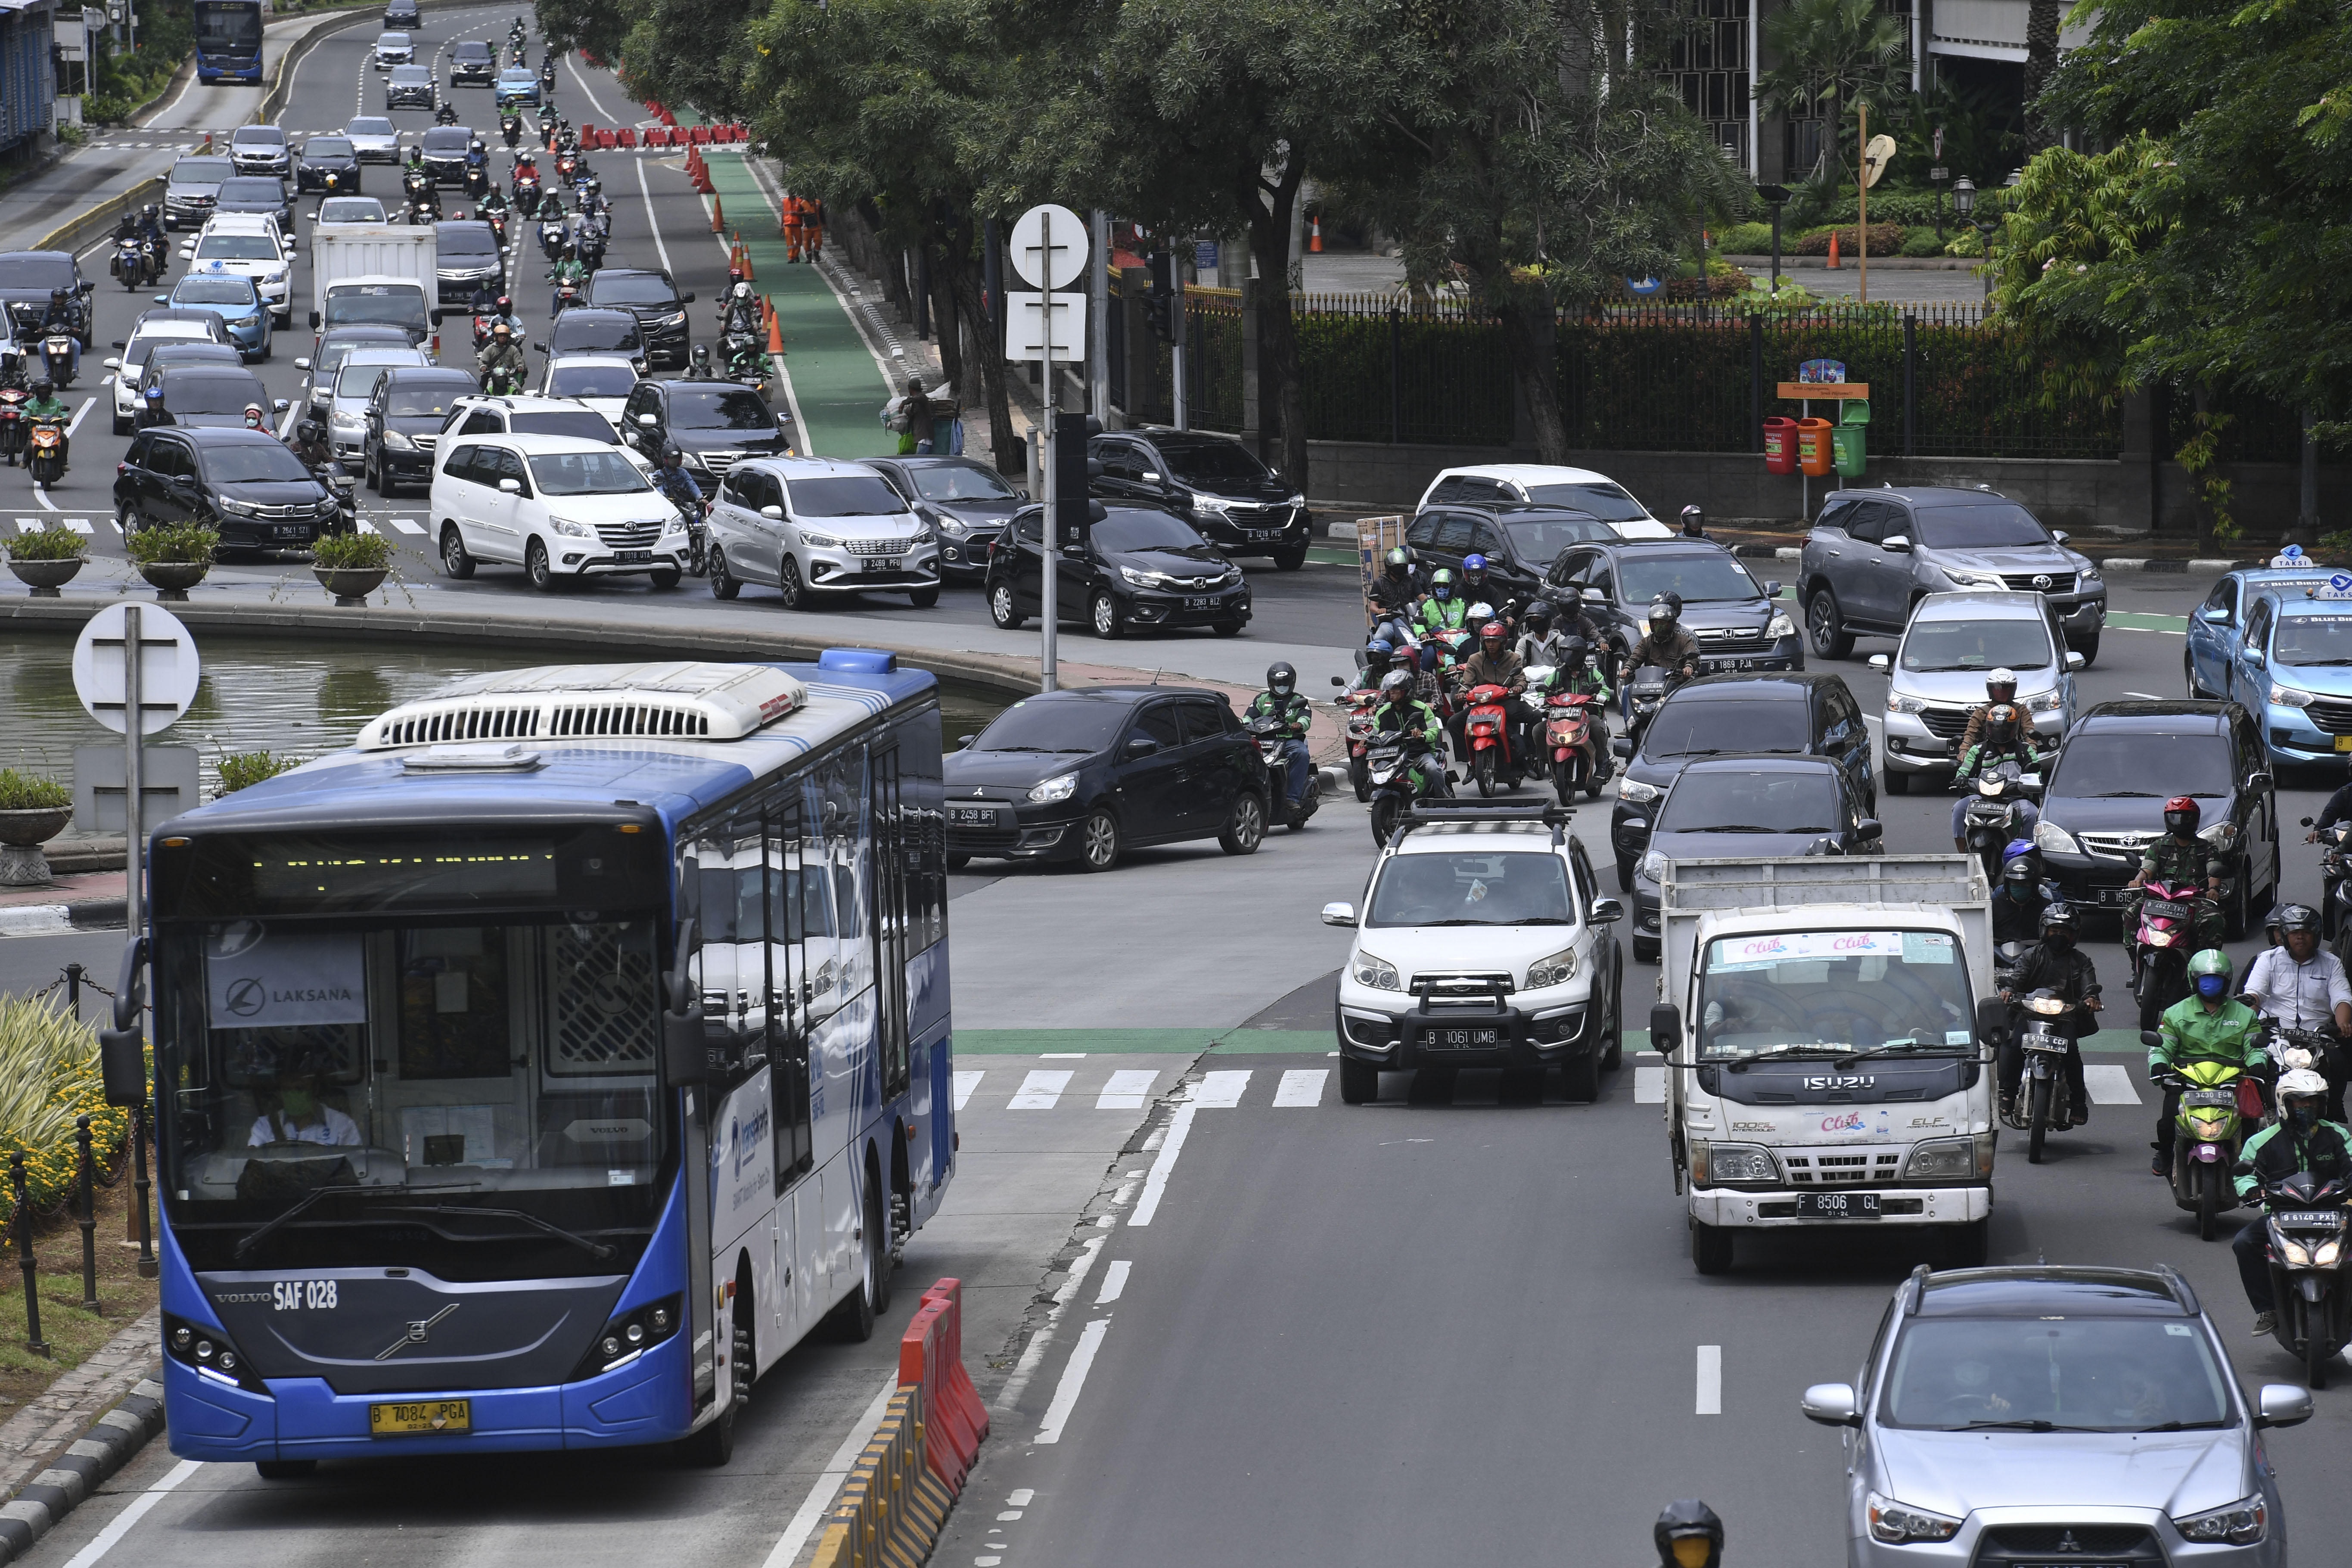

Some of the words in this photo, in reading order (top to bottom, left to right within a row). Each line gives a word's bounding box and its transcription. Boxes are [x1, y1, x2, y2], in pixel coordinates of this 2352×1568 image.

[1710, 661, 1714, 670] B
[1720, 660, 1735, 669] 1869
[1740, 659, 1752, 668] PJA
[2338, 738, 2343, 746] B
[951, 810, 955, 819] B
[961, 810, 978, 820] 2458
[982, 810, 994, 820] BFT
[2101, 891, 2106, 902] B
[2116, 891, 2132, 902] 1619
[1744, 937, 1780, 954] Club
[1833, 933, 1870, 950] Club
[273, 989, 351, 1003] LAKSANA
[1429, 1032, 1435, 1044] B
[1447, 1031, 1468, 1043] 1061
[1474, 1031, 1495, 1043] UMB
[1804, 1076, 1875, 1090] ISUZU
[1821, 1111, 1859, 1132] Club
[1912, 1117, 1945, 1125] ELF
[1799, 1195, 1805, 1209] F
[1818, 1195, 1847, 1209] 8506
[1864, 1195, 1878, 1209] GL
[215, 1293, 272, 1303] VOLVO
[273, 1282, 302, 1310] SAF
[307, 1280, 338, 1309] 028
[373, 1407, 381, 1423] B
[393, 1405, 426, 1422] 7084
[440, 1403, 466, 1419] PGA
